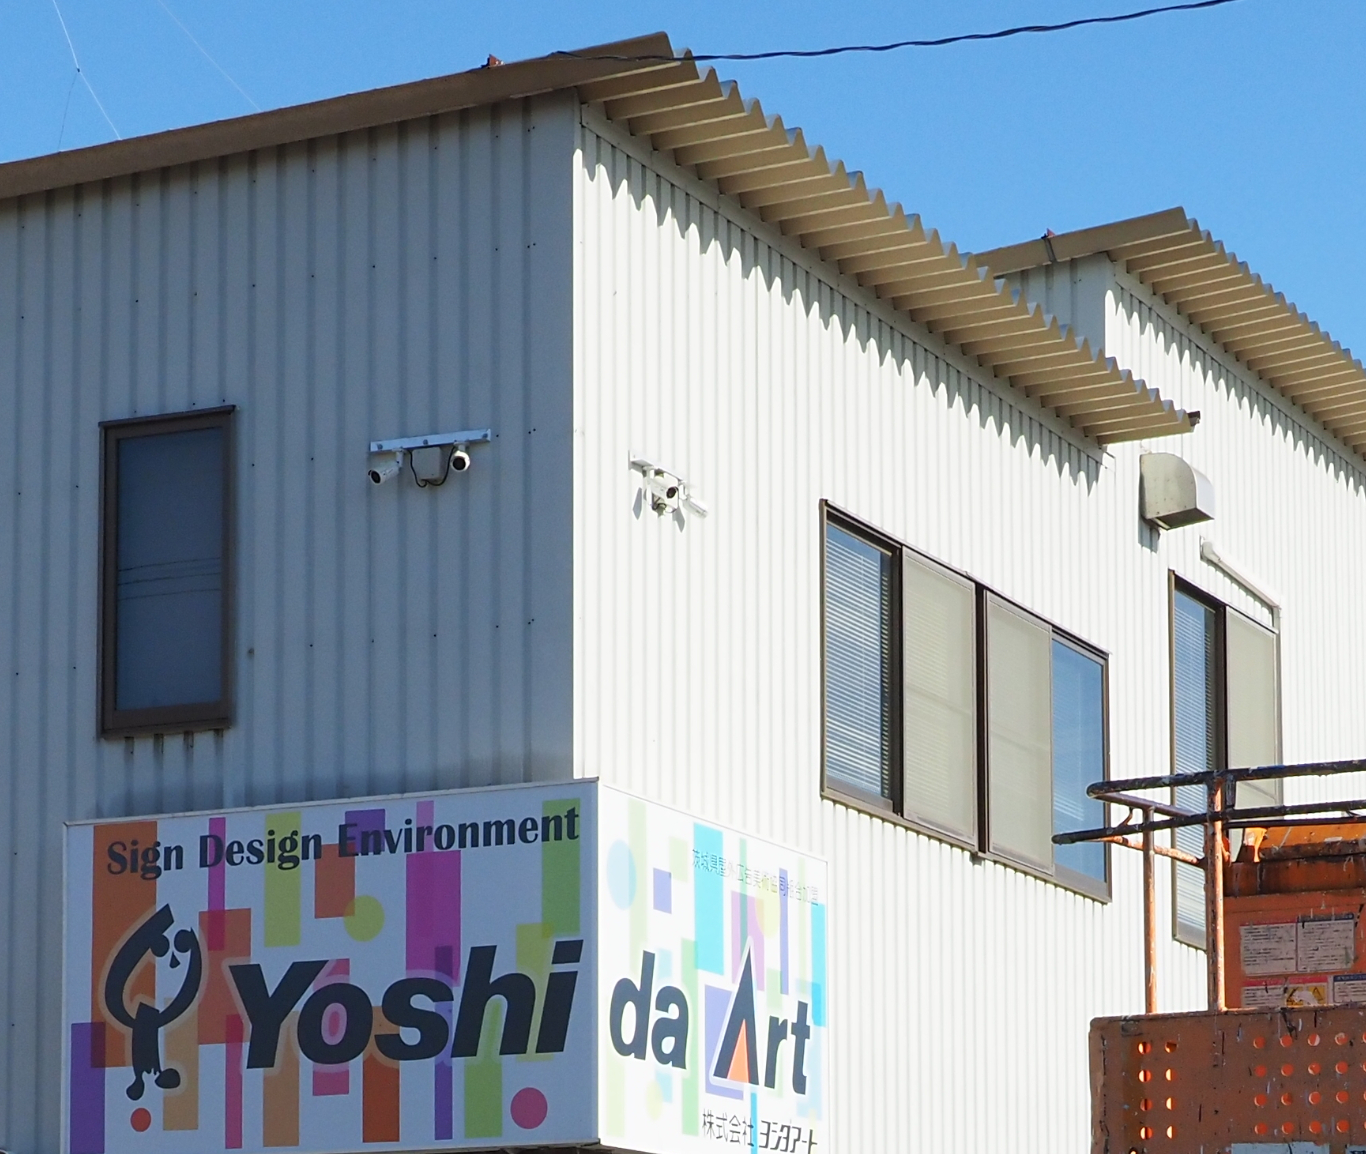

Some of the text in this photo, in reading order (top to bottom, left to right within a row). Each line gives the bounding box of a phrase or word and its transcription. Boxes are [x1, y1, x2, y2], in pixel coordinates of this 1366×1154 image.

[106, 806, 580, 880] Sign Design Environment
[228, 939, 584, 1070] Yoshi
[609, 945, 811, 1096] da Art
[701, 1108, 754, 1148] 株式会社
